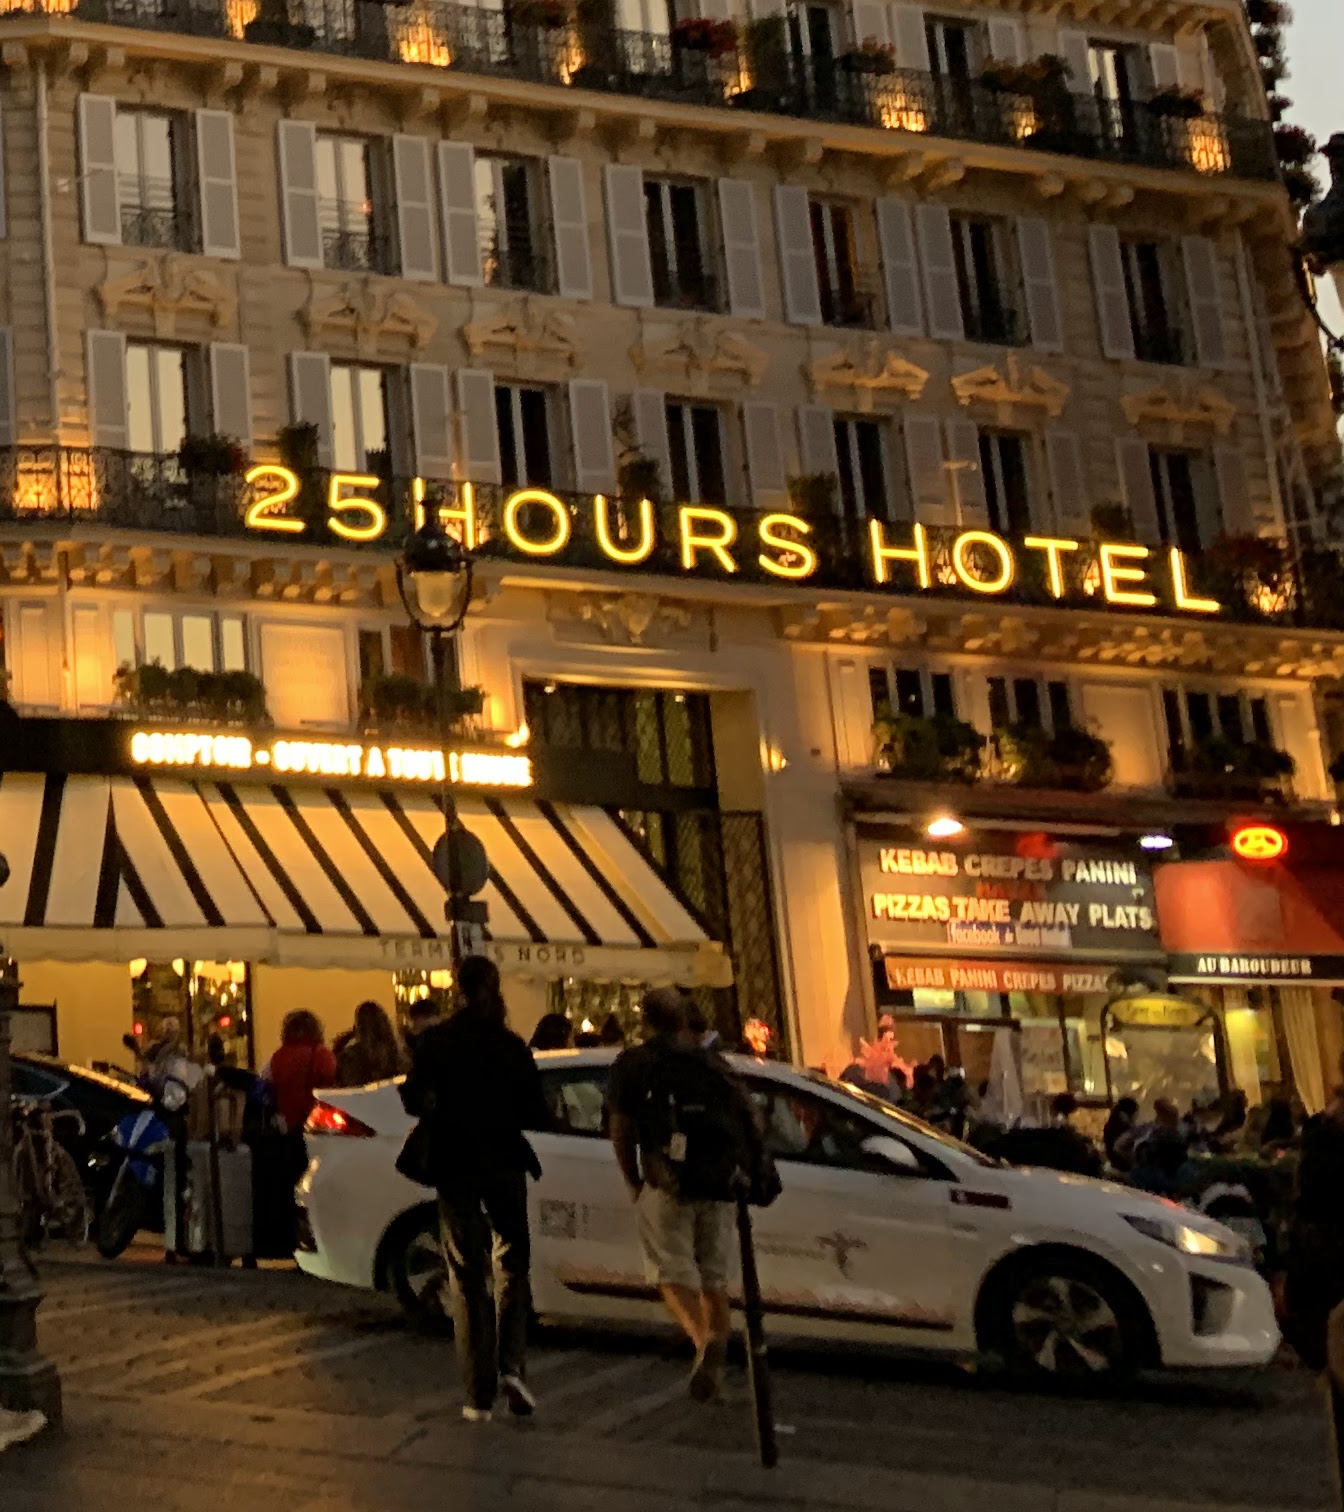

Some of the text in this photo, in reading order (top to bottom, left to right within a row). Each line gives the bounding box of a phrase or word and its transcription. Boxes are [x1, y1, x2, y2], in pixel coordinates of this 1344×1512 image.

[869, 518, 1221, 612] HOTEL
[879, 848, 1137, 885] KEBAB CREPES PANINI
[873, 892, 1153, 930] PIZZAS TAKE AWAY PLATS
[518, 946, 586, 965] NORD
[1197, 956, 1218, 973] AU
[895, 967, 945, 986] KEBAB
[950, 968, 998, 989] PANINI
